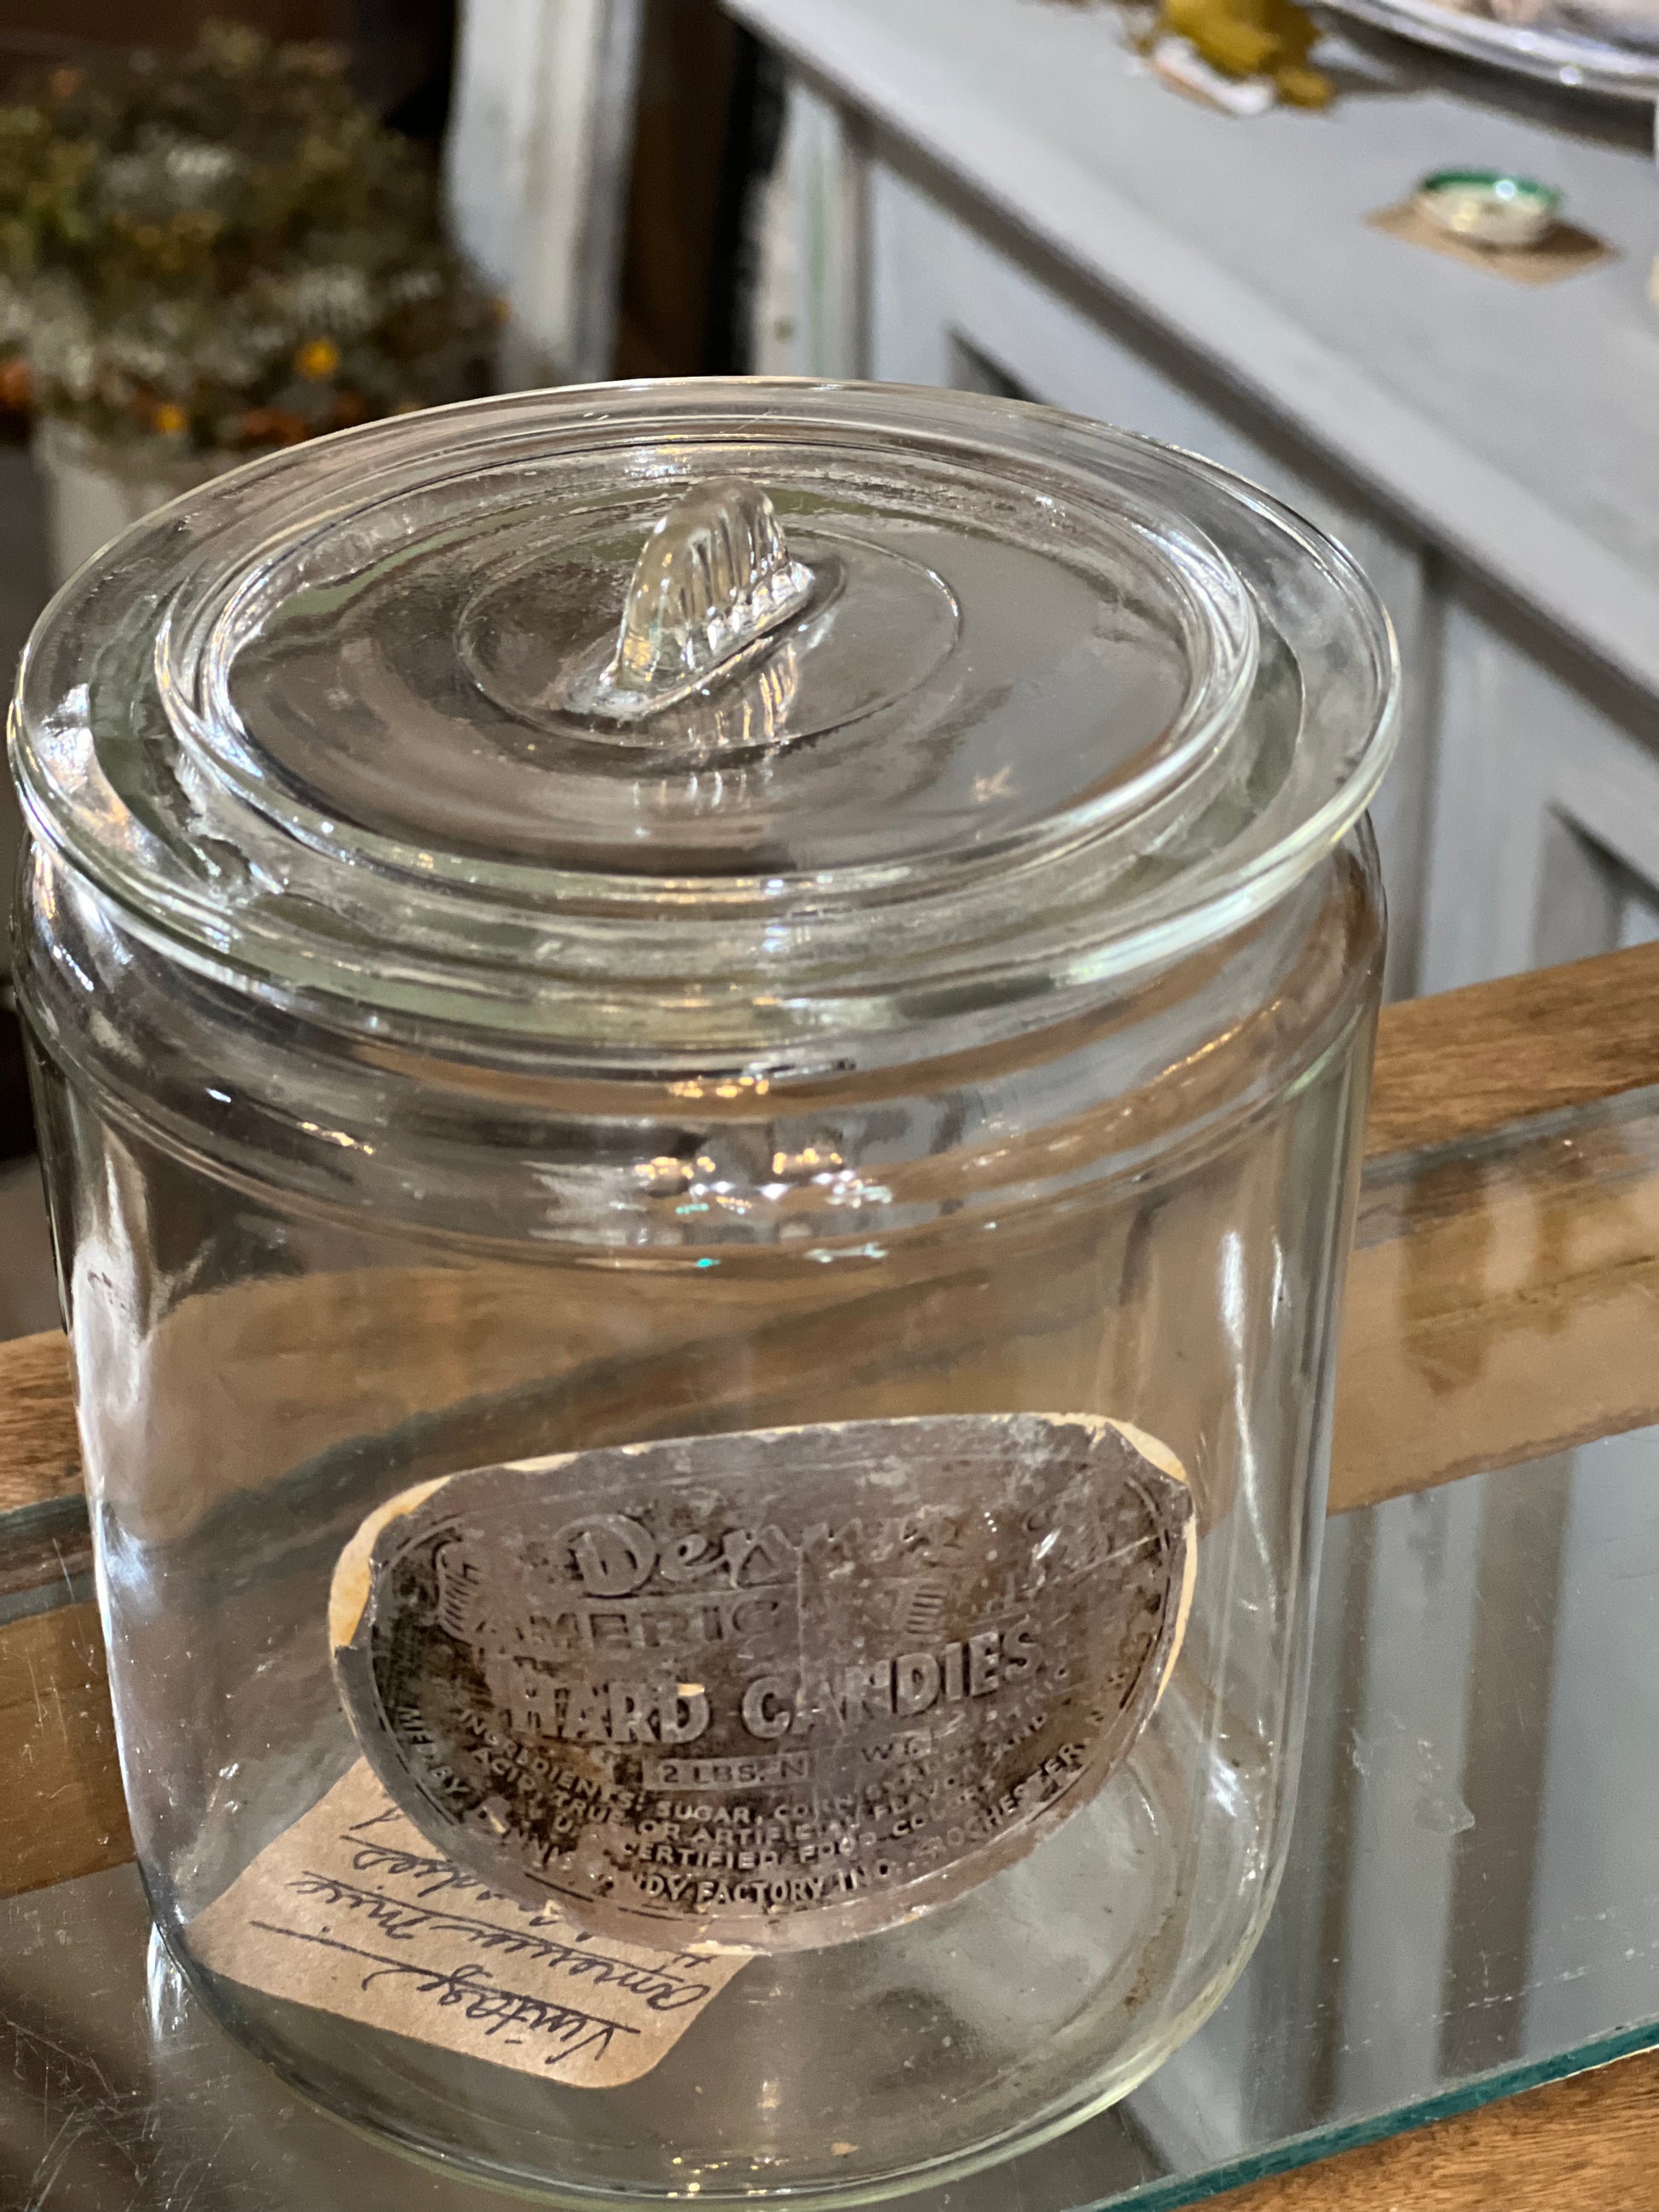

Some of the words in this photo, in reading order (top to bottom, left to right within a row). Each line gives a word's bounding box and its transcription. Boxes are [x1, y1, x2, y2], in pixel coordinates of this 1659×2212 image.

[512, 1671, 710, 1745] HARD
[742, 1622, 1045, 1740] CANDIES
[658, 1764, 680, 1784] 2
[639, 1818, 680, 1840] OR
[361, 1962, 620, 2066] Vintage
